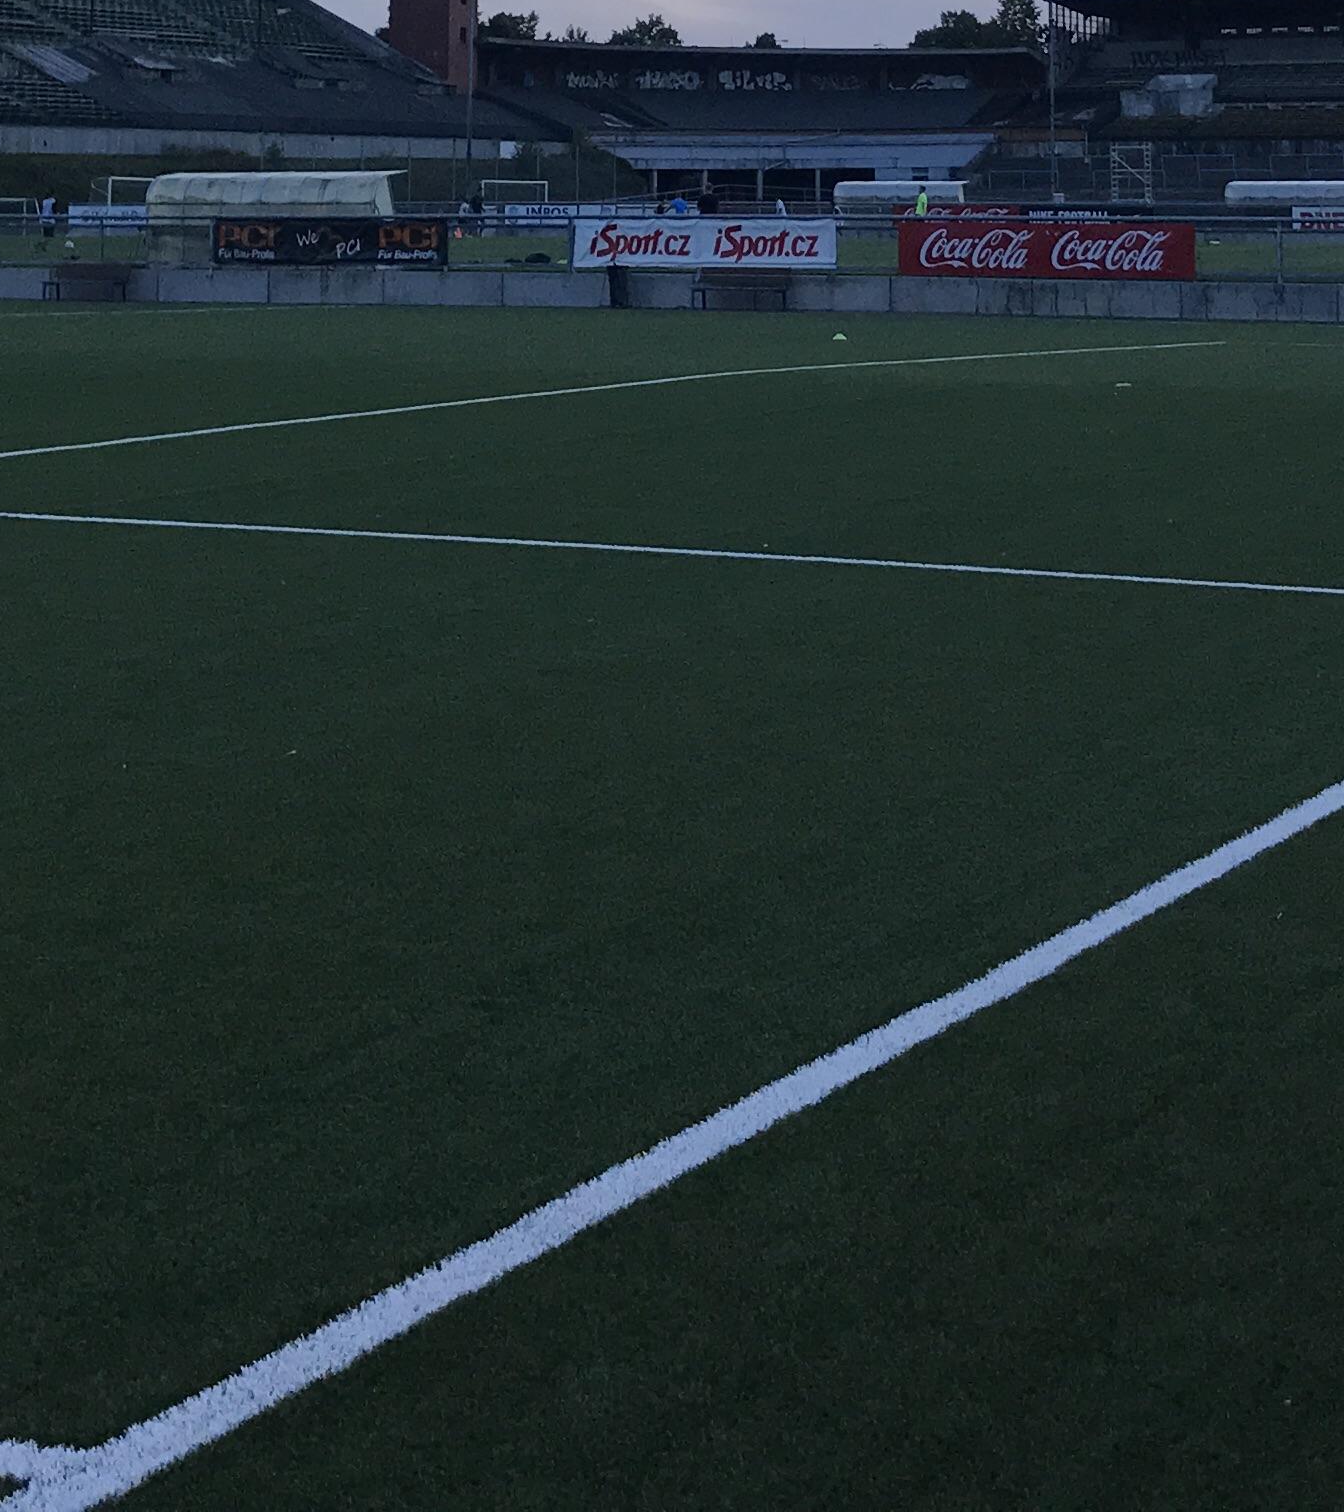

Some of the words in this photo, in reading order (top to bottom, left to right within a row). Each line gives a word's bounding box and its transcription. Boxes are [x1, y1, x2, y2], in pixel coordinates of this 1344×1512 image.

[296, 229, 320, 247] We
[377, 224, 439, 248] PCI
[590, 224, 692, 261] iSport.cz
[713, 224, 819, 263] iSport.cz
[336, 238, 361, 259] PCI
[919, 228, 1035, 269] Coca-Cola
[1050, 229, 1172, 271] Coca-Cola
